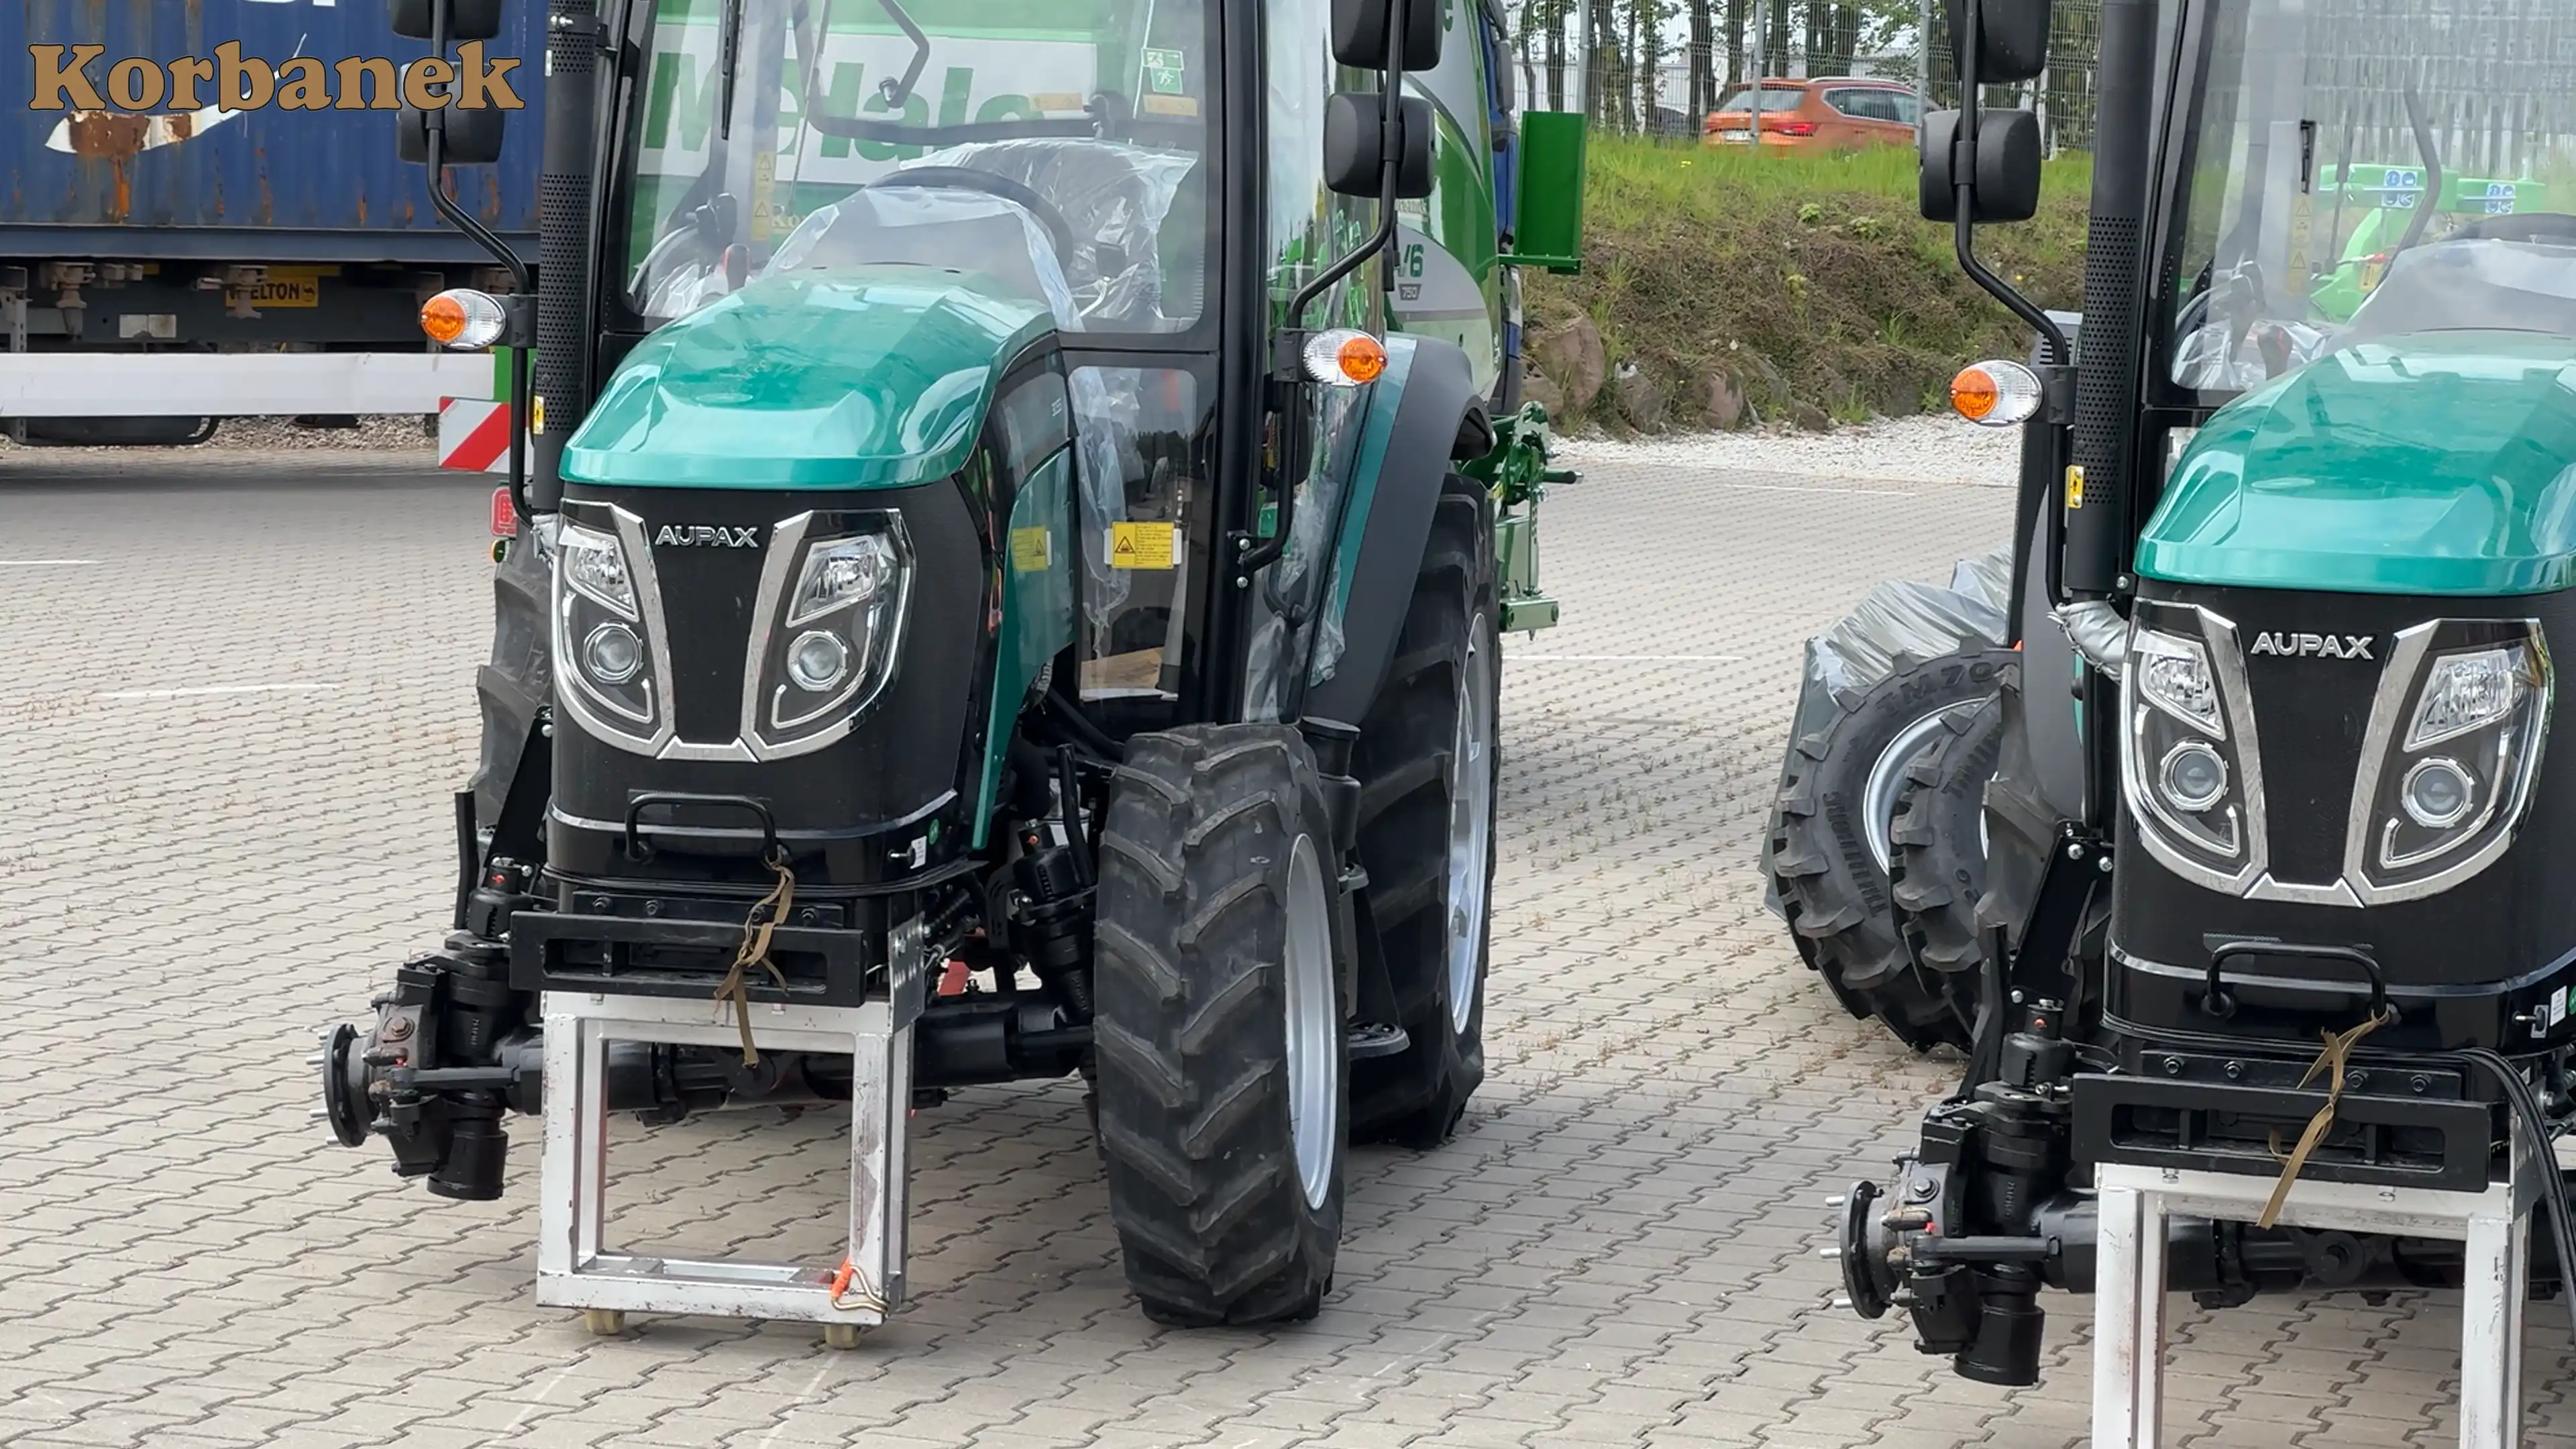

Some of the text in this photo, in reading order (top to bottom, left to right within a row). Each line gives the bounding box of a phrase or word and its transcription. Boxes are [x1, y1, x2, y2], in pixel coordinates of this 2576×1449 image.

[655, 525, 758, 548] AUPAX
[2251, 631, 2374, 660] AUPAX
[1876, 661, 2018, 716] TM70
